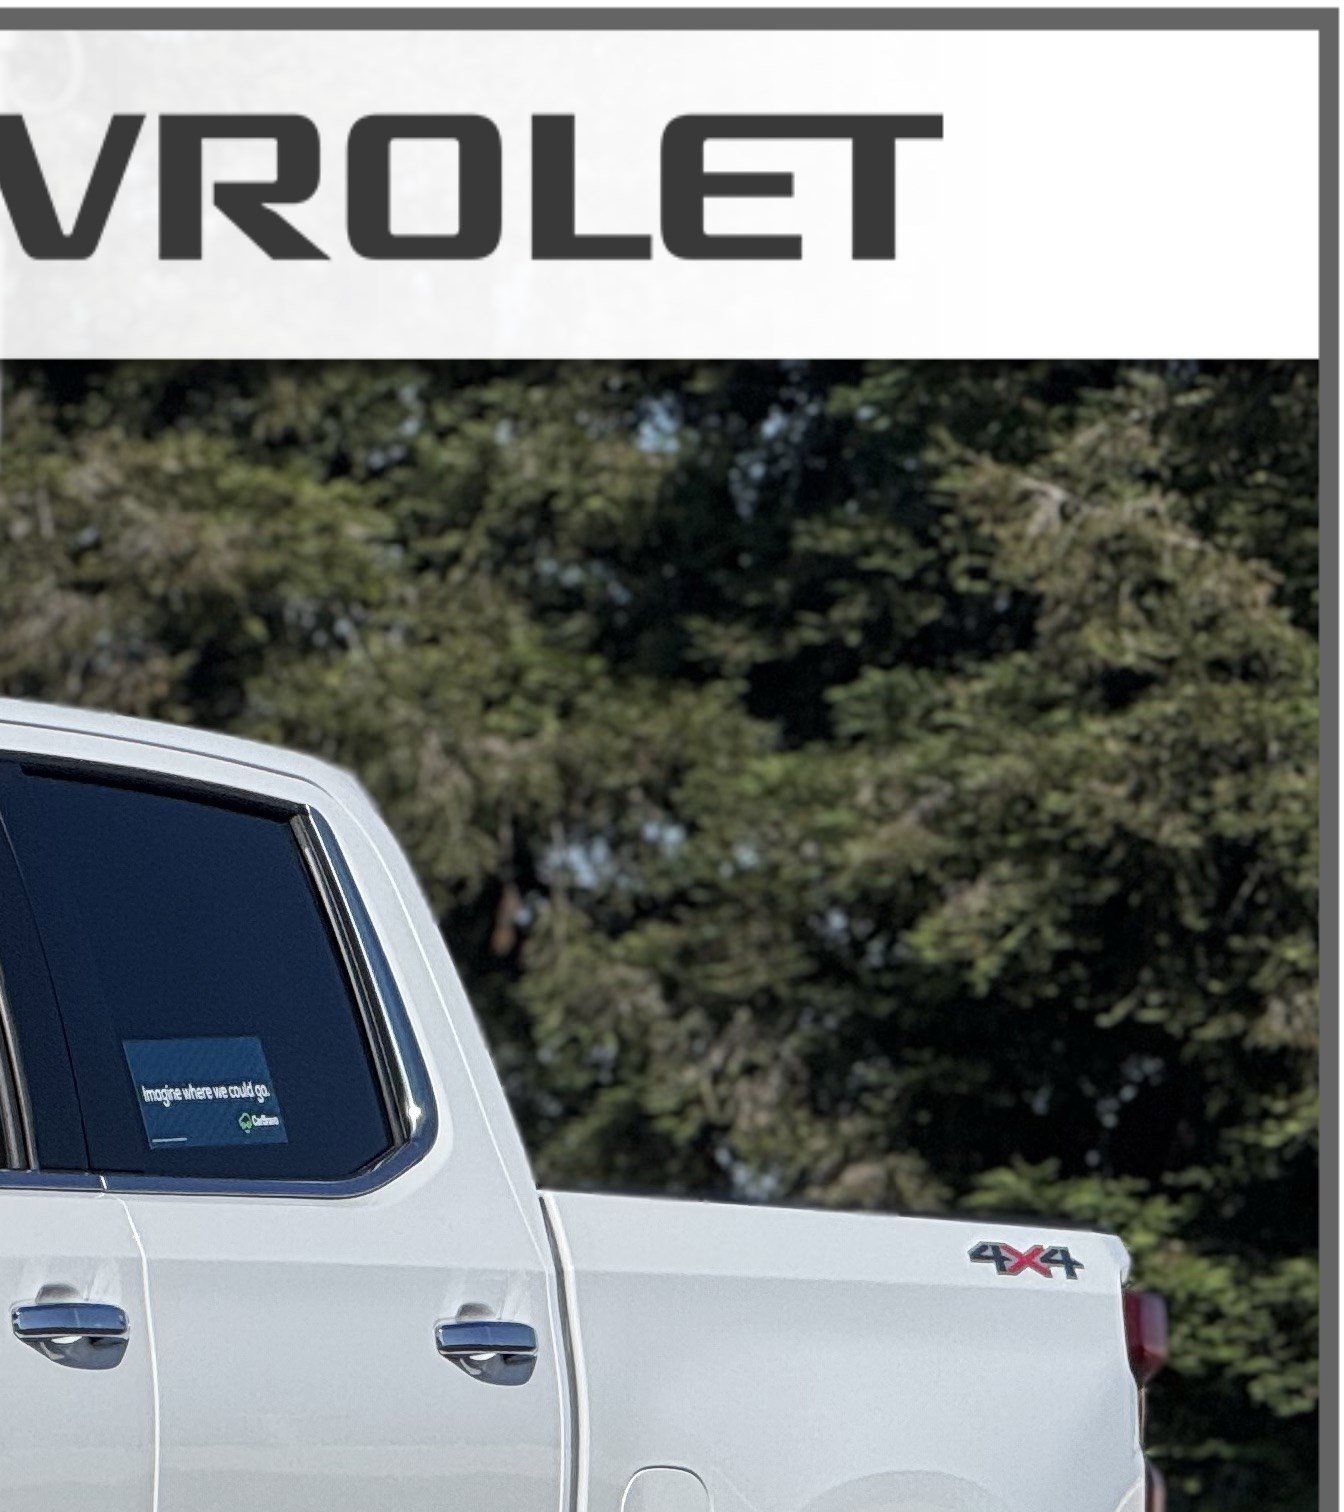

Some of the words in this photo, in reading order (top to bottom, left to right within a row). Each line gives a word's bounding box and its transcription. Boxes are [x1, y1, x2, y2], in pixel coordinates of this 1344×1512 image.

[142, 1085, 182, 1107] Imagine
[182, 1084, 212, 1100] where
[213, 1087, 228, 1099] we
[229, 1081, 253, 1098] could
